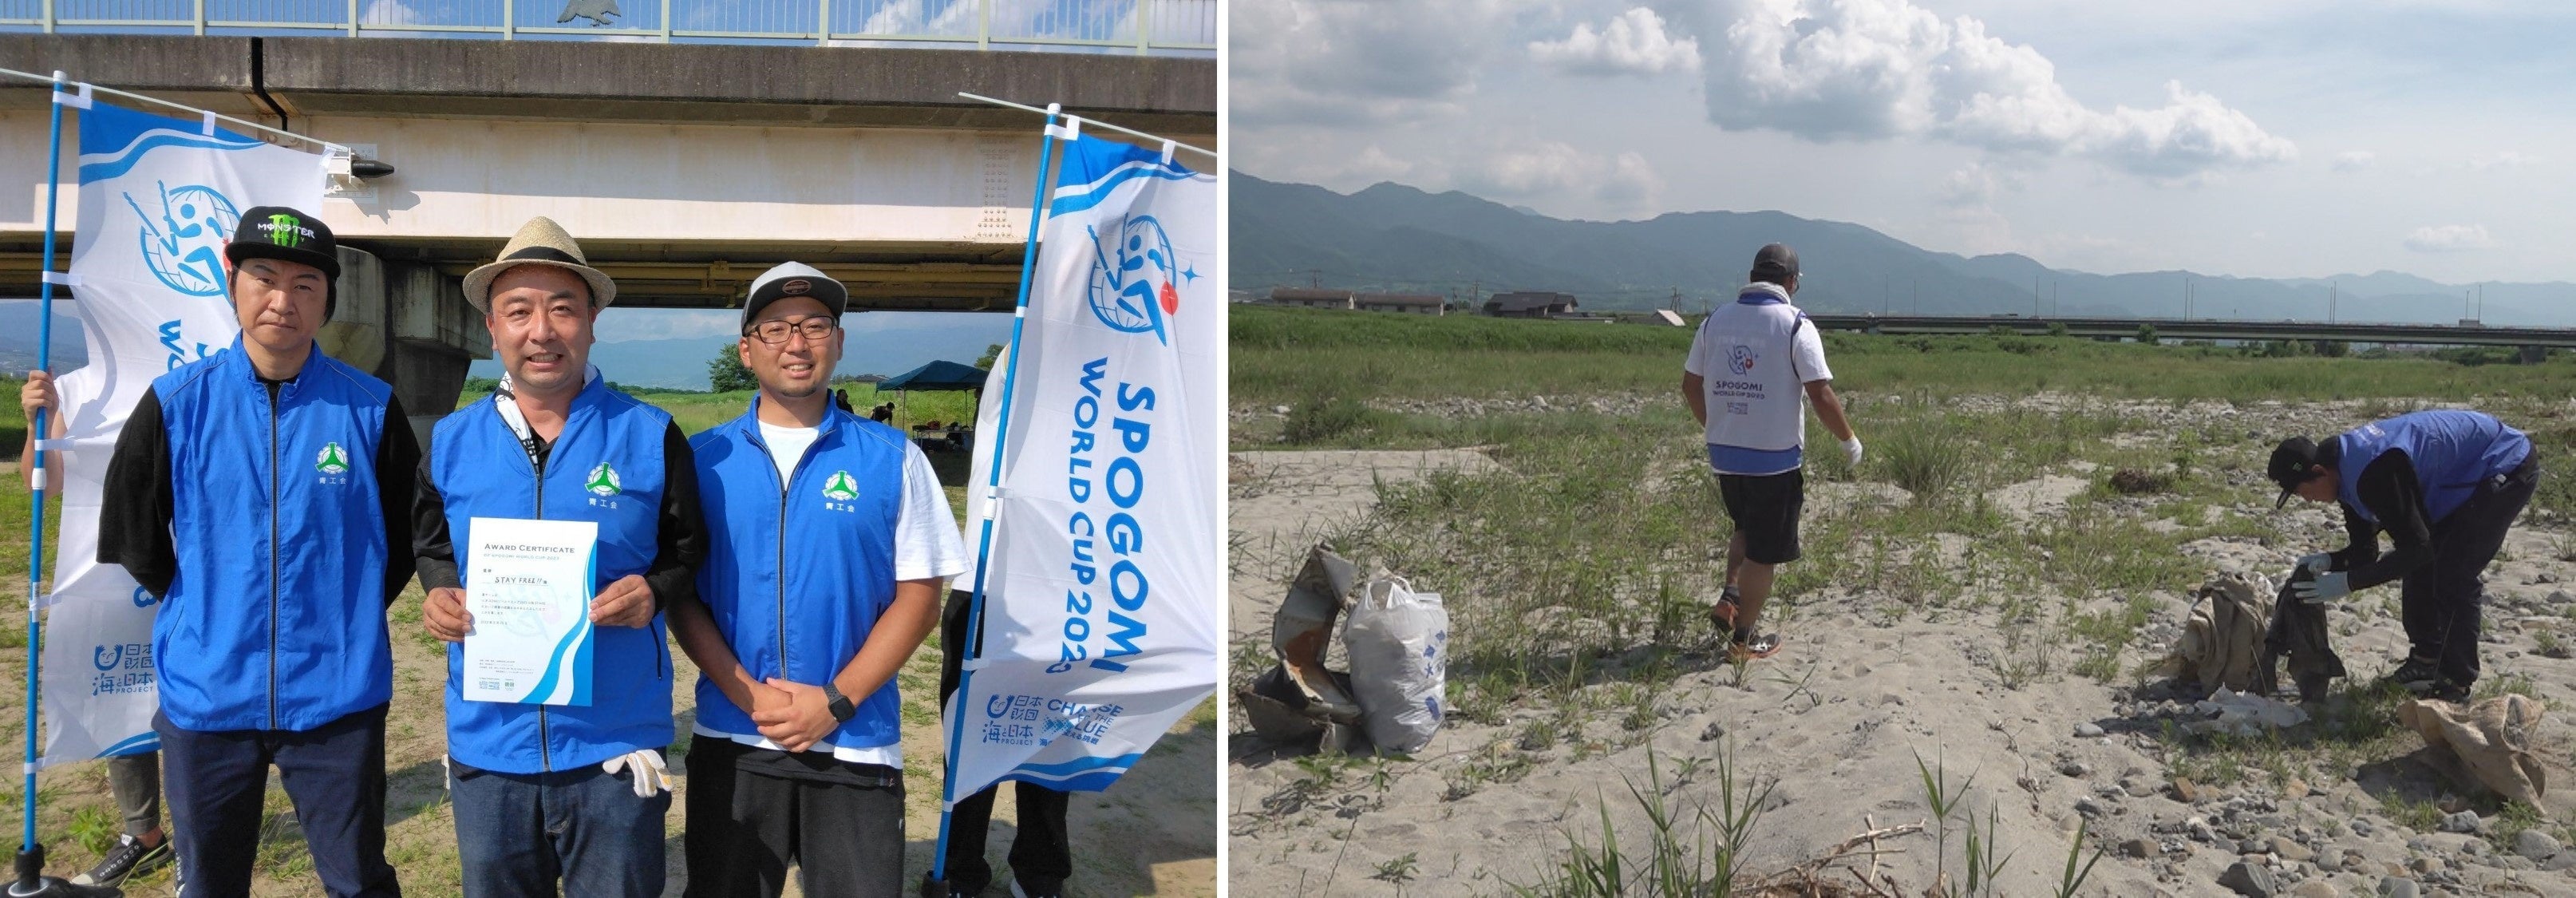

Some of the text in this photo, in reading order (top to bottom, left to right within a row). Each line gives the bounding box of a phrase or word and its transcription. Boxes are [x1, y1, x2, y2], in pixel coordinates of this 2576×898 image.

[1716, 381, 1763, 391] SPOGOMI
[1069, 356, 1108, 504] WORLD
[1089, 382, 1156, 673] SPOGOMI
[519, 544, 575, 553] CERTIFICATE
[1069, 511, 1096, 585] CUP
[1014, 694, 1043, 707] 日本
[1095, 714, 1114, 726] THE
[1075, 720, 1108, 738] LUE
